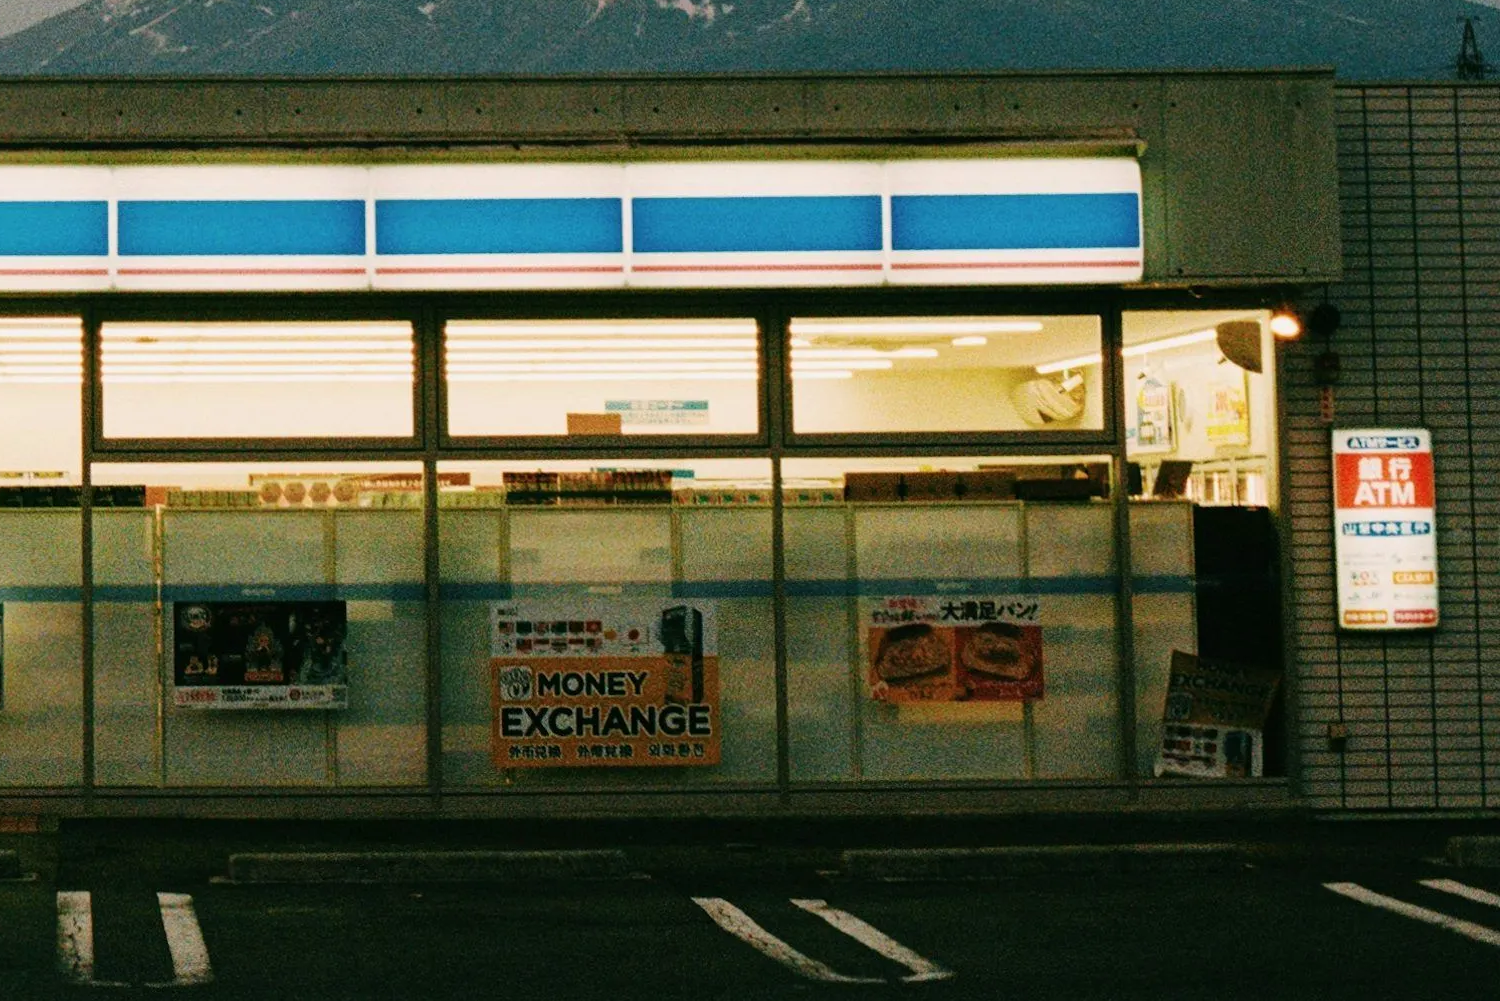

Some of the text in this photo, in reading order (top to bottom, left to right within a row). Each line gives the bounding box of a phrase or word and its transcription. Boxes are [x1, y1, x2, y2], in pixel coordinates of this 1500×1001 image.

[1358, 457, 1413, 480] 銀行
[1353, 481, 1416, 506] ATM
[538, 672, 647, 696] MONEY
[501, 706, 711, 736] EXCHANGE
